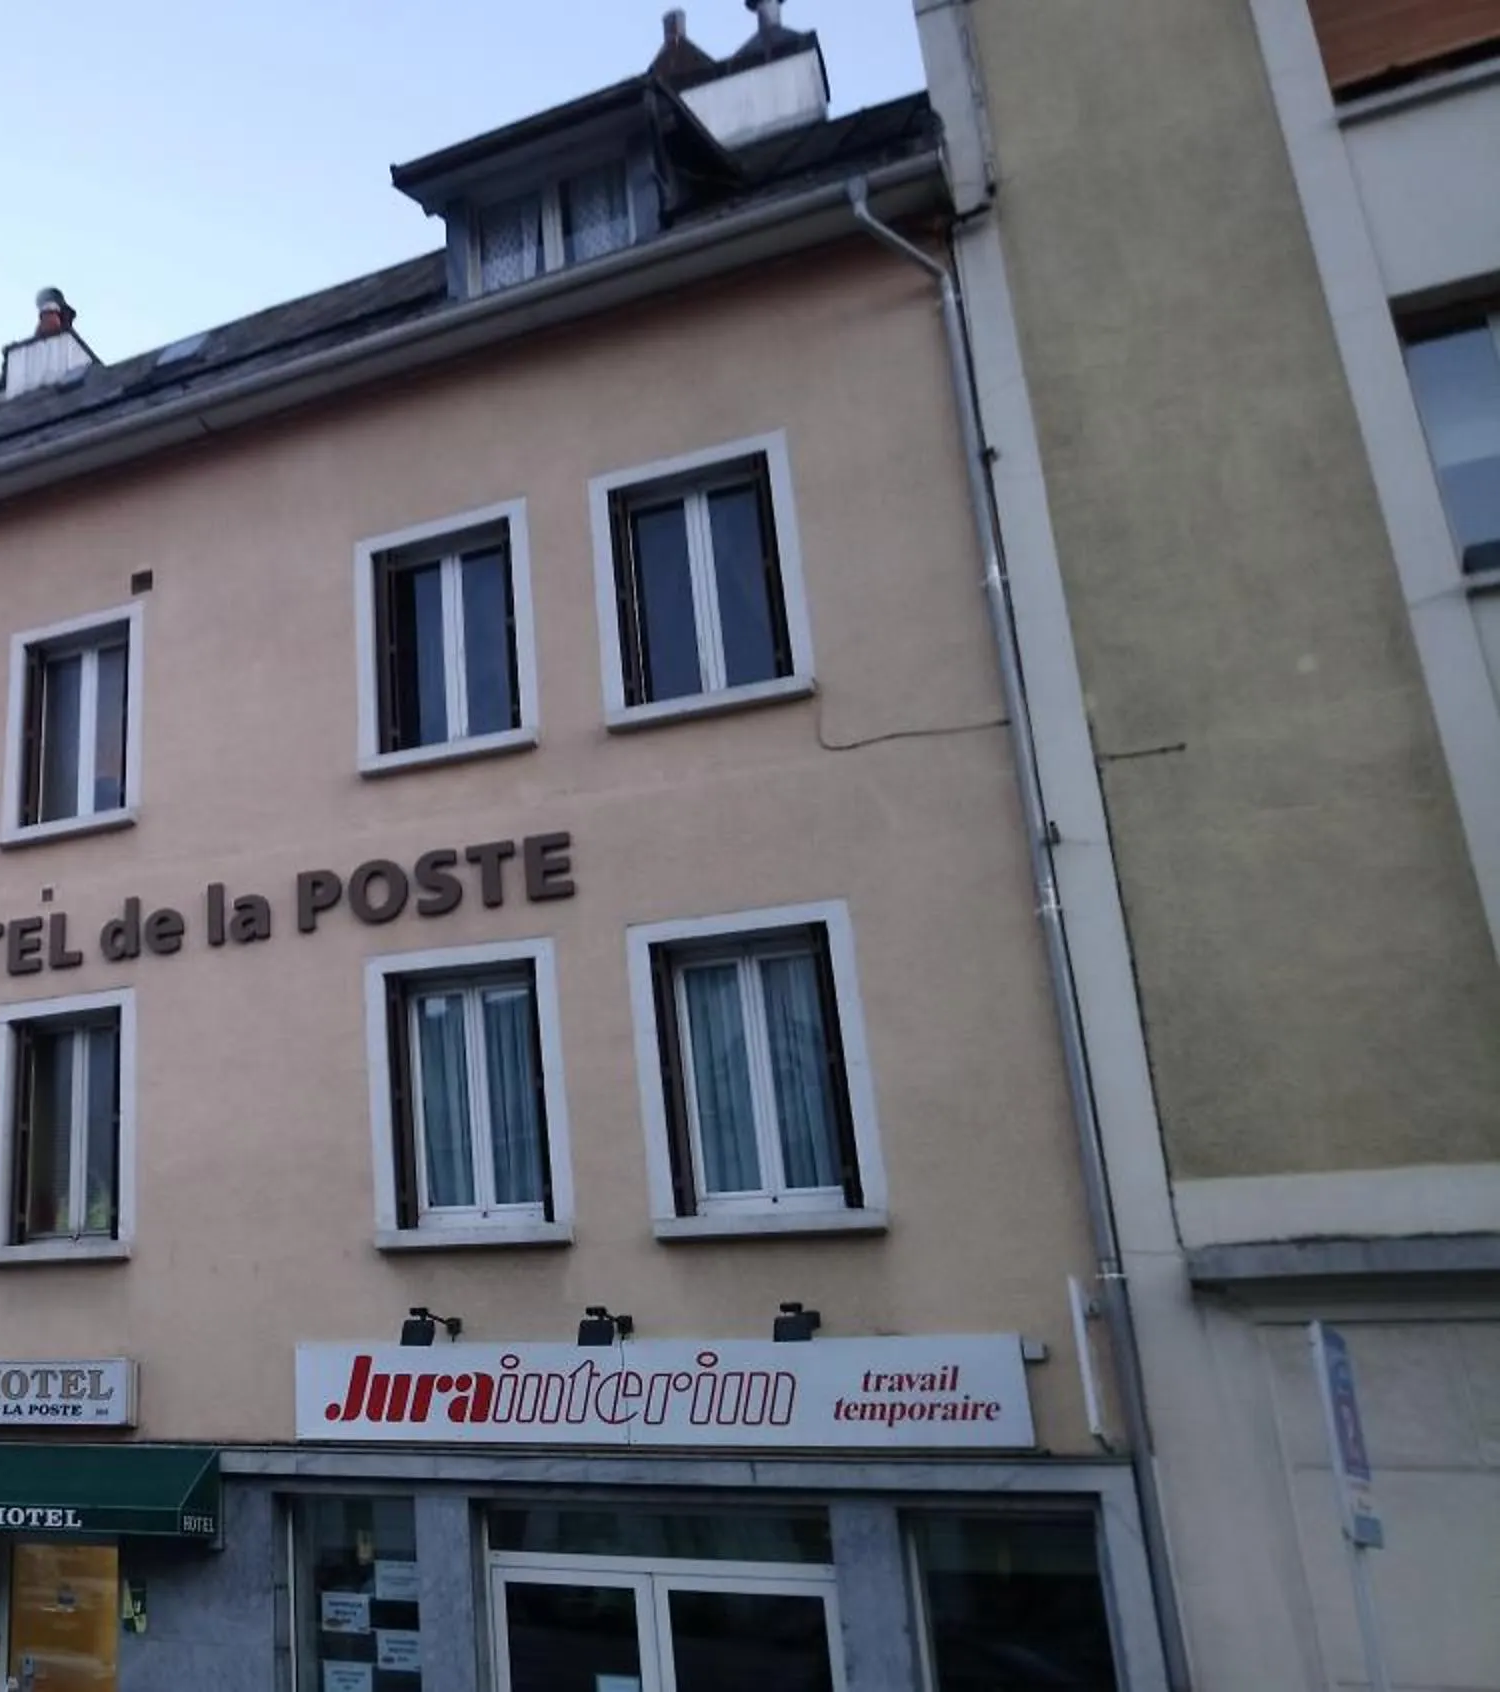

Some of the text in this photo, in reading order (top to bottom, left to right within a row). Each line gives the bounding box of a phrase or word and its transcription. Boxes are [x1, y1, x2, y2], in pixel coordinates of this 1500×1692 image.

[100, 897, 185, 963] de
[207, 884, 272, 947] la
[296, 831, 577, 934] POSTE
[862, 1365, 960, 1393] travail
[2, 1404, 24, 1416] LA
[27, 1404, 83, 1417] POSTE
[833, 1395, 1002, 1428] temporaire
[183, 1514, 215, 1534] HOTEL
